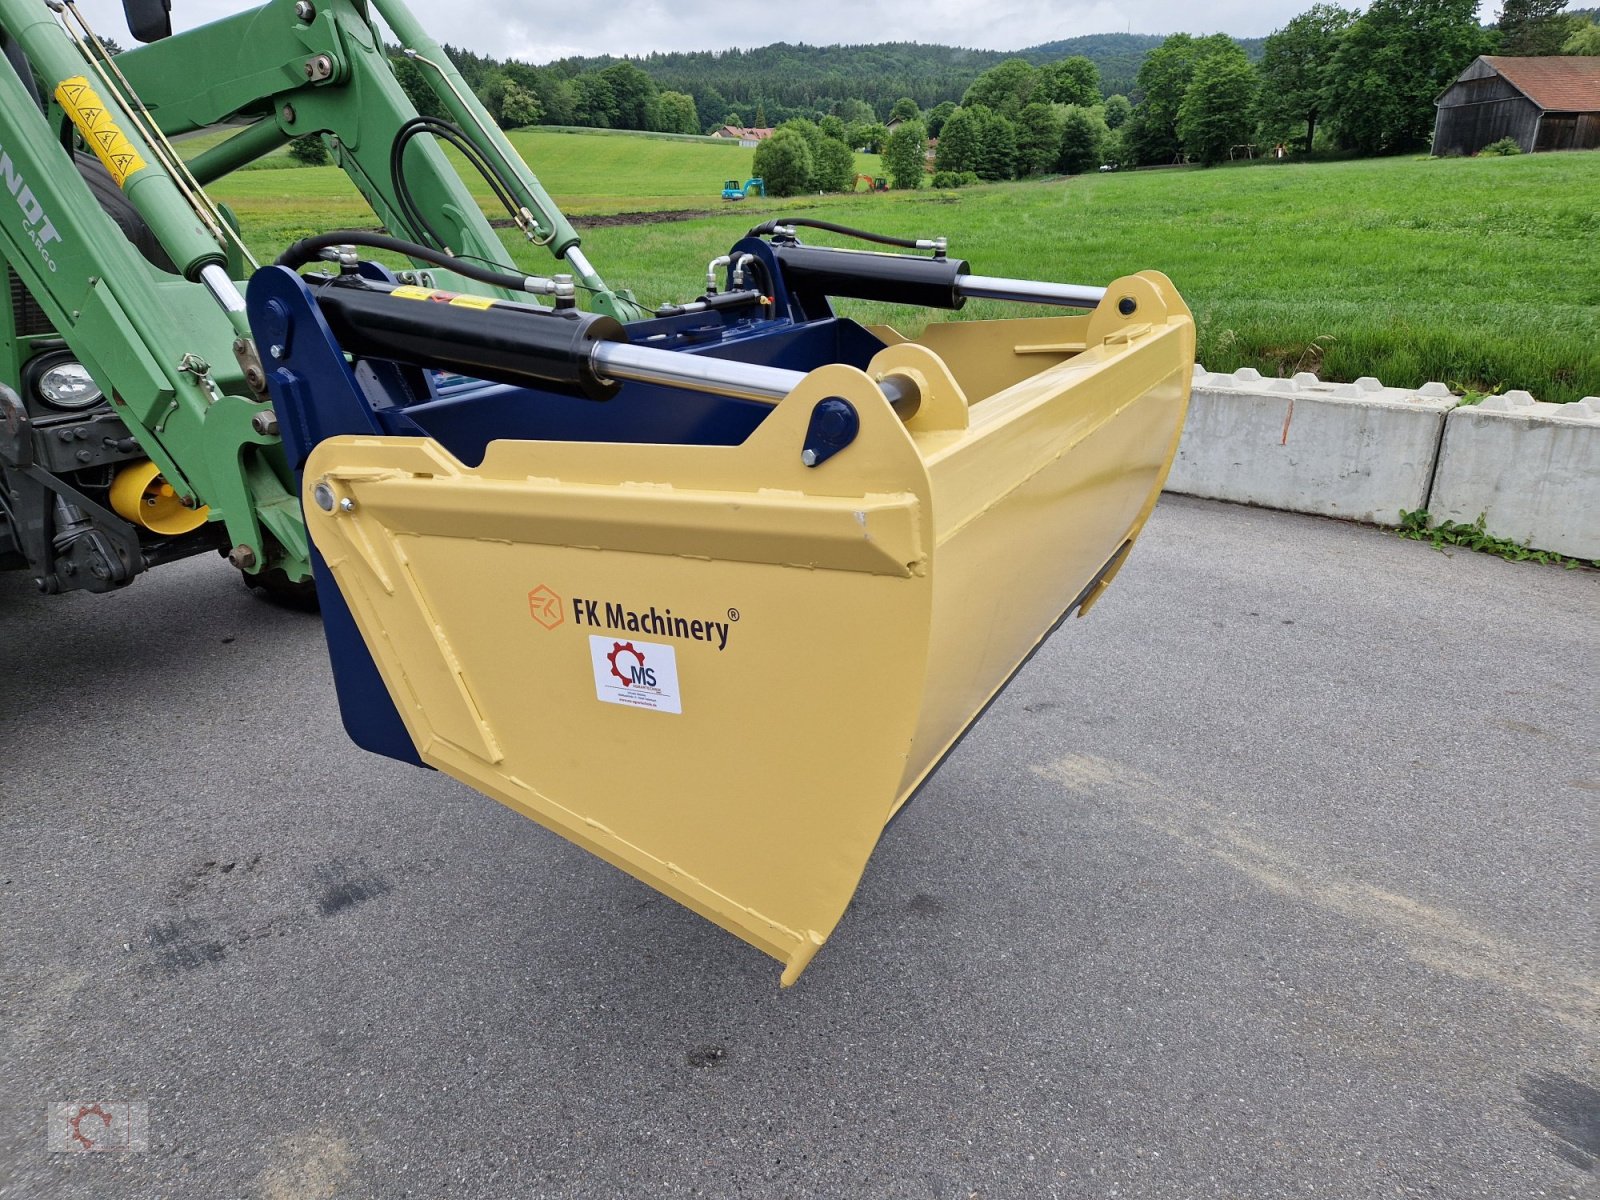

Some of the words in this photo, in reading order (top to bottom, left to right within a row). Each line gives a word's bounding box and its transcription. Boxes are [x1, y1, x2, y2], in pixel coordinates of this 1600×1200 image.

[0, 145, 63, 244] NDT
[22, 219, 57, 273] CARGO
[572, 598, 602, 628] FK
[631, 666, 656, 686] MS
